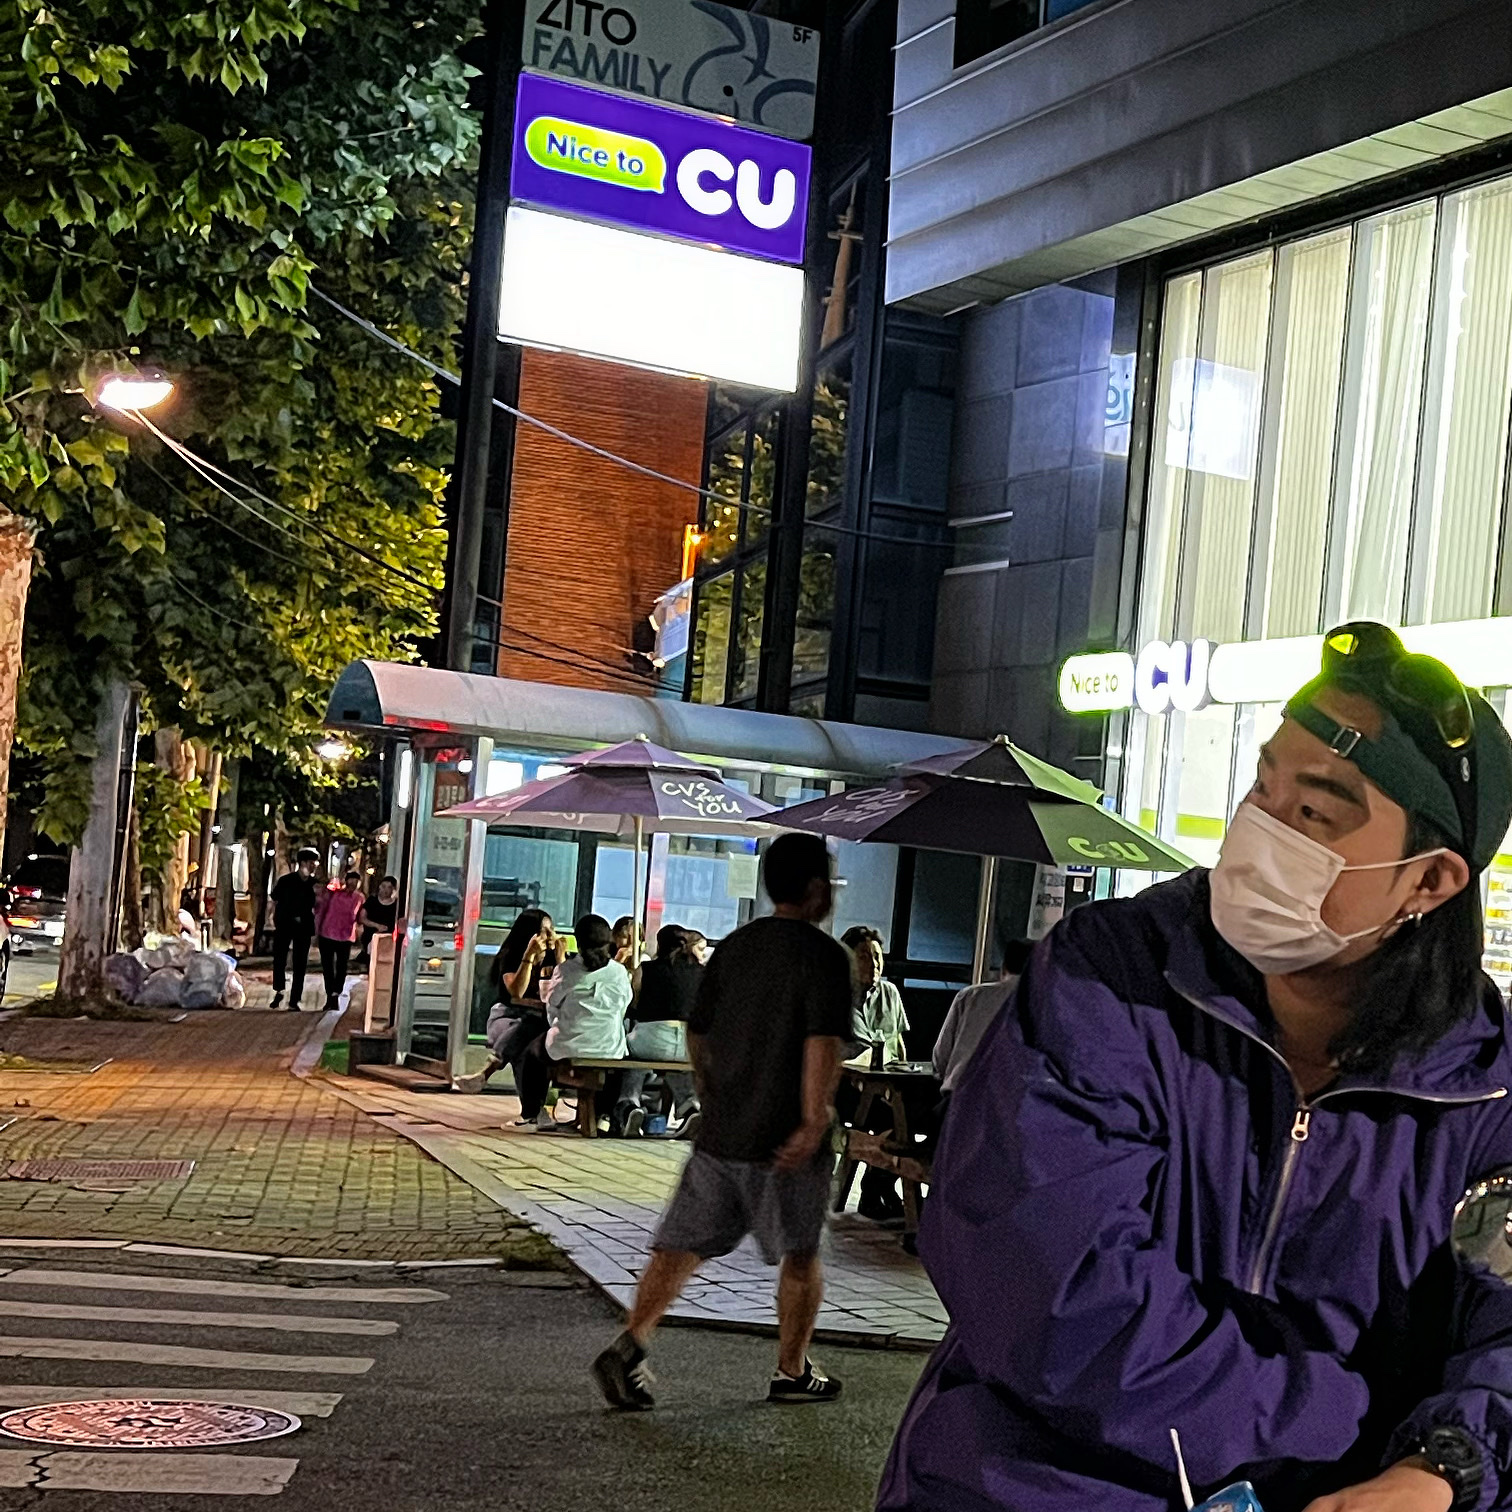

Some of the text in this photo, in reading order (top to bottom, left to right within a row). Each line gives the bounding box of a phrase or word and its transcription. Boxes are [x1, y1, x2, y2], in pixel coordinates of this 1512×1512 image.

[536, 0, 637, 46] ZITO
[793, 26, 812, 44] 5F
[531, 28, 672, 99] FAMILY
[546, 131, 797, 230] Nice to CU
[1070, 638, 1211, 715] Nice to CU
[661, 782, 710, 797] CVS
[1067, 836, 1151, 863] CU
